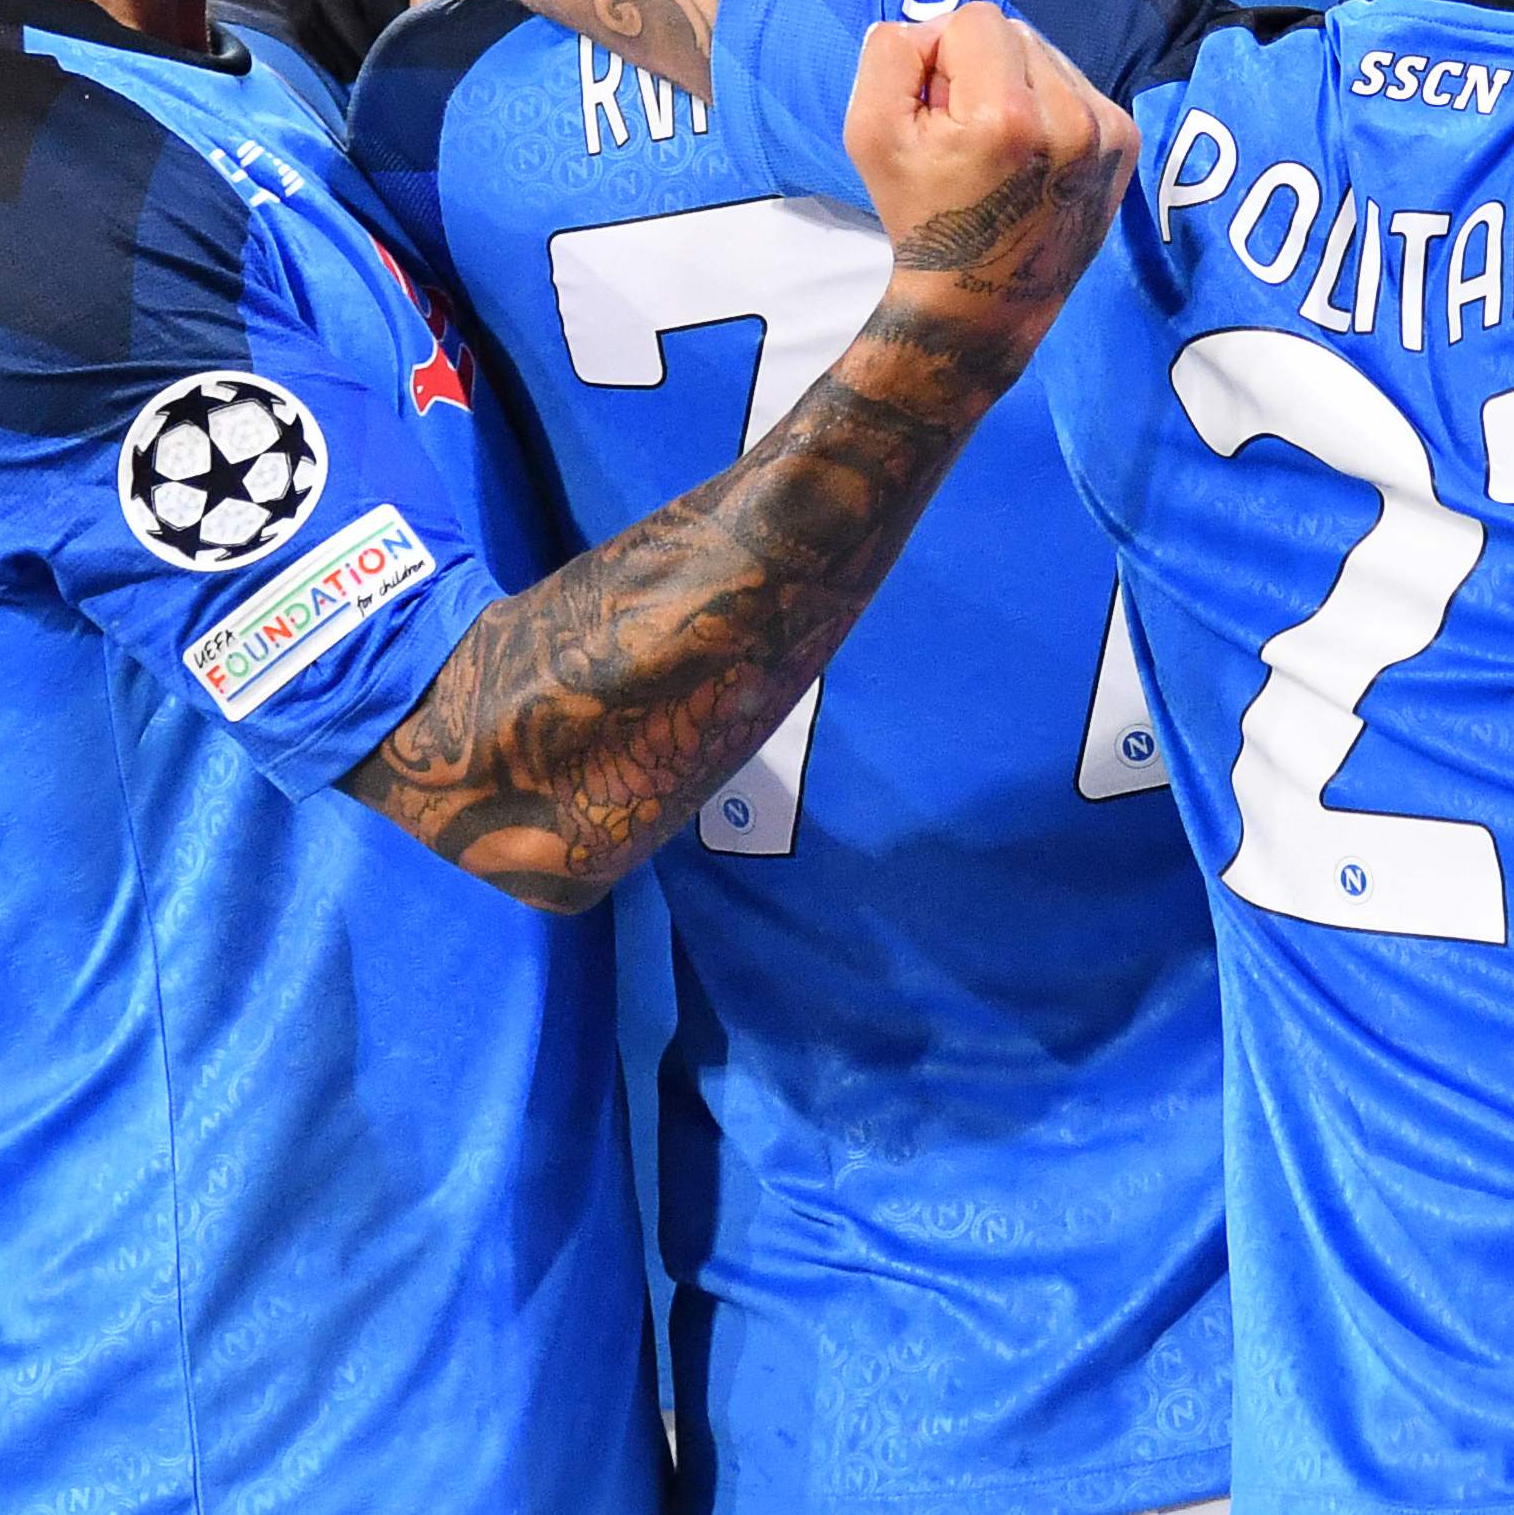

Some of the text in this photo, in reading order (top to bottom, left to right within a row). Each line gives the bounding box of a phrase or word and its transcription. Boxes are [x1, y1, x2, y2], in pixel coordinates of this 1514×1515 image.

[1351, 50, 1514, 114] SSCN
[356, 558, 426, 618] for children
[193, 628, 237, 669] UEFA
